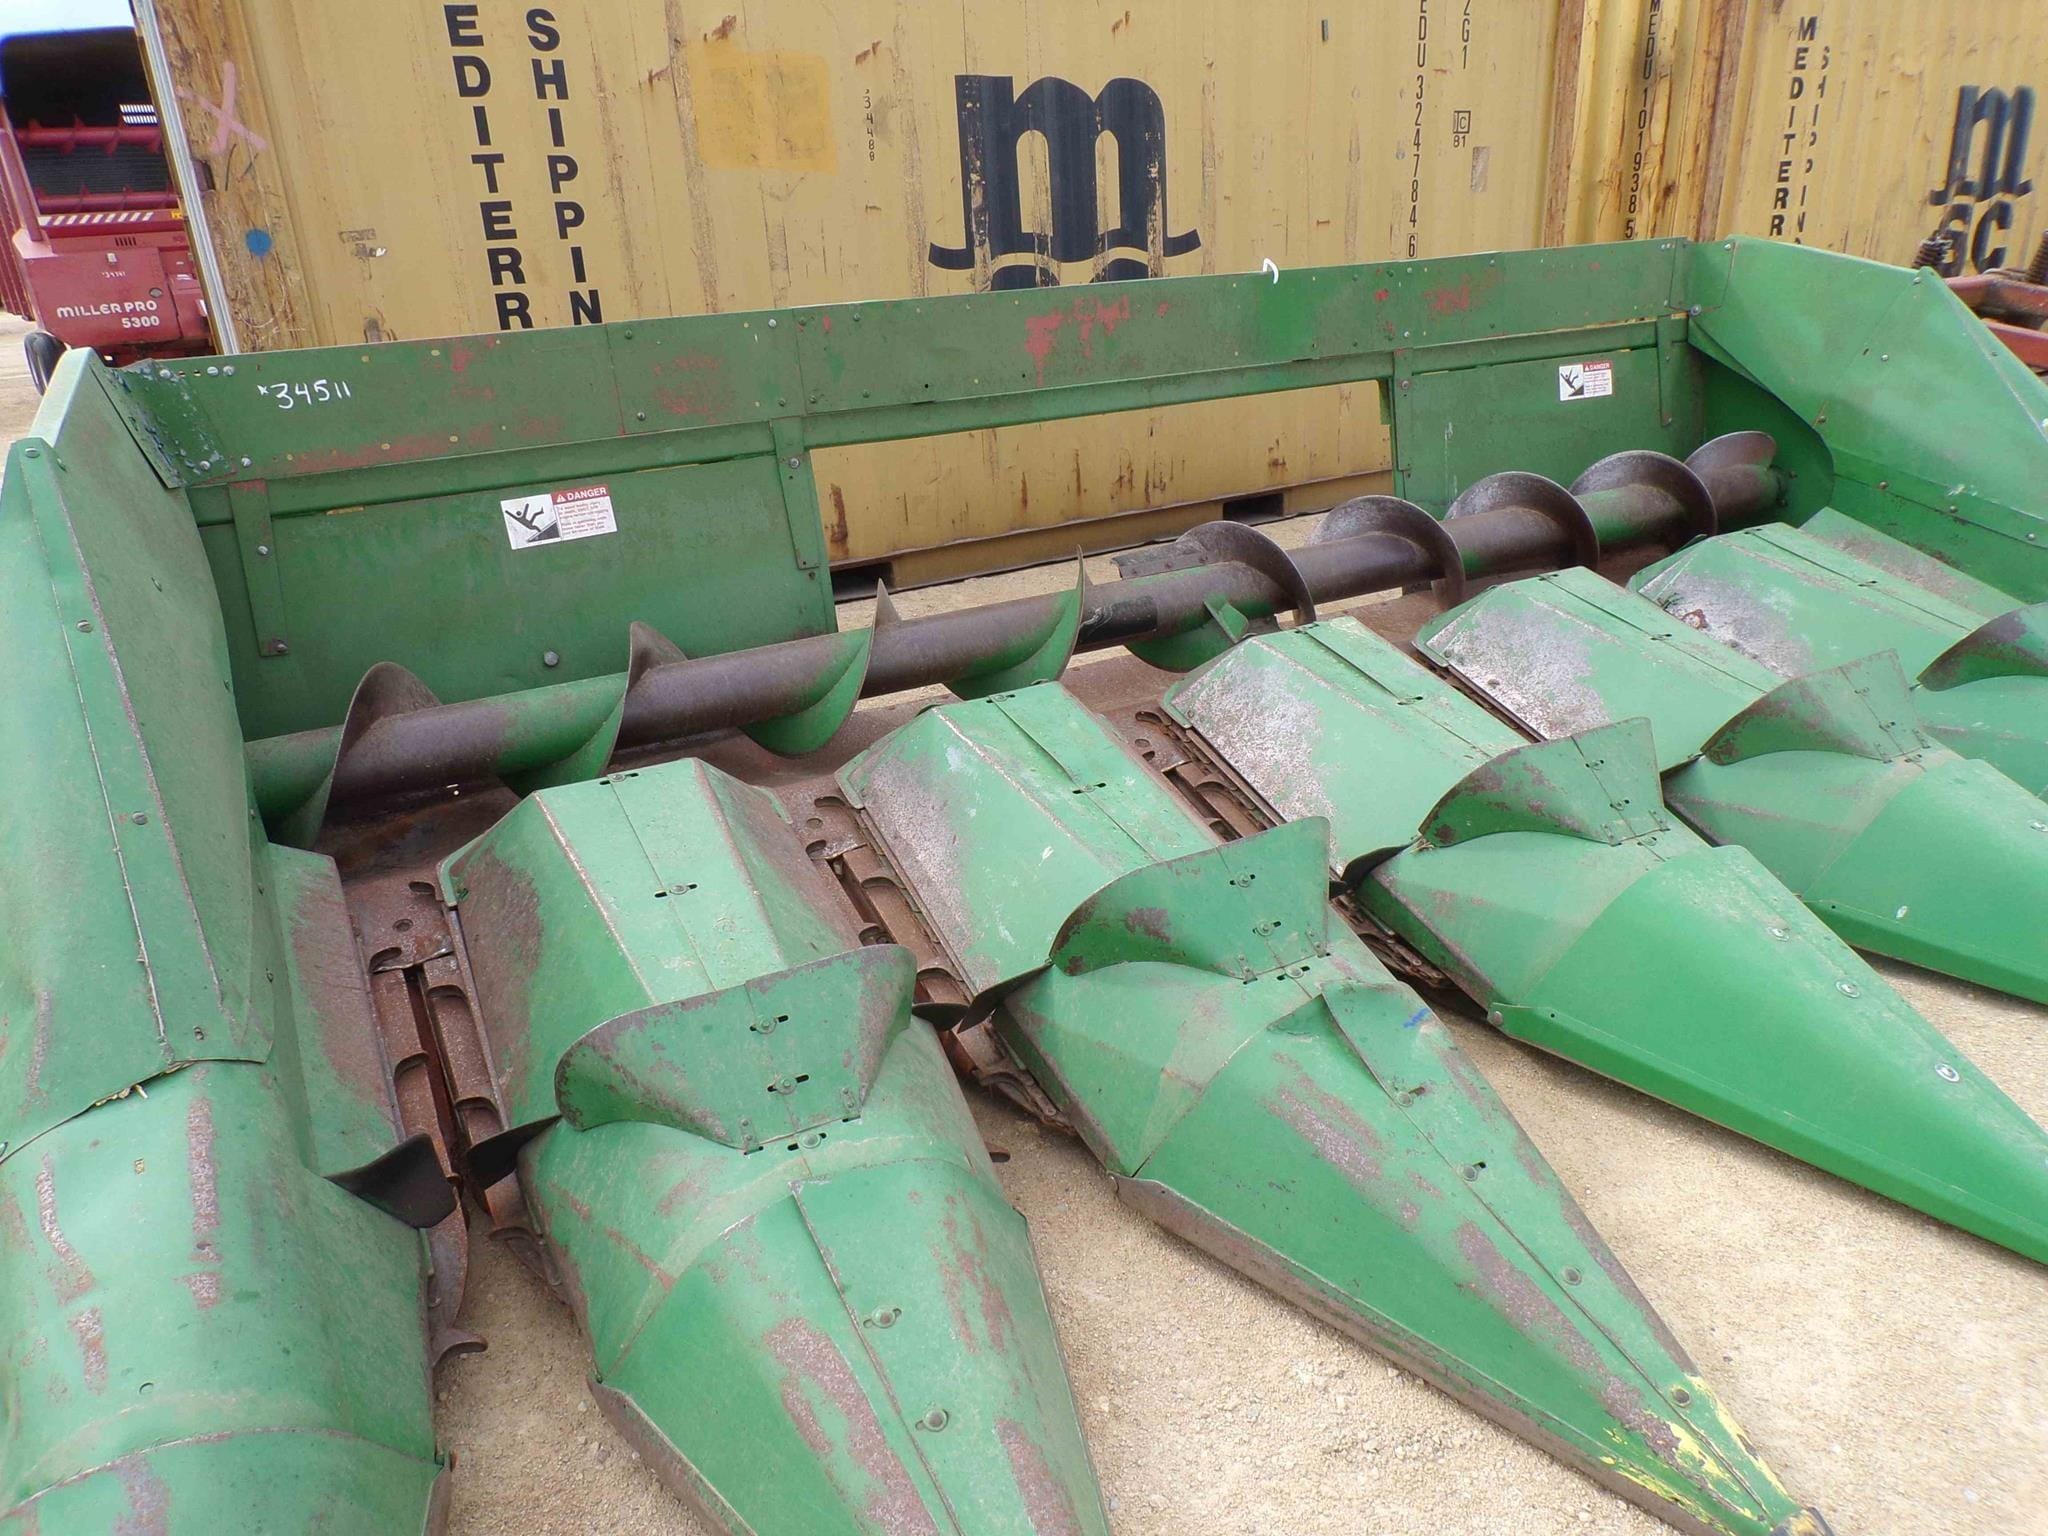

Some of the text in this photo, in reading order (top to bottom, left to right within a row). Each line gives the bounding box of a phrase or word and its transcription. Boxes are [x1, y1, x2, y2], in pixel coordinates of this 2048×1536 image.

[1453, 135, 1466, 148] 81
[1409, 75, 1424, 228] 324784
[57, 300, 158, 319] MILLER PRO
[122, 315, 160, 329] 5300
[567, 487, 607, 501] DANGER
